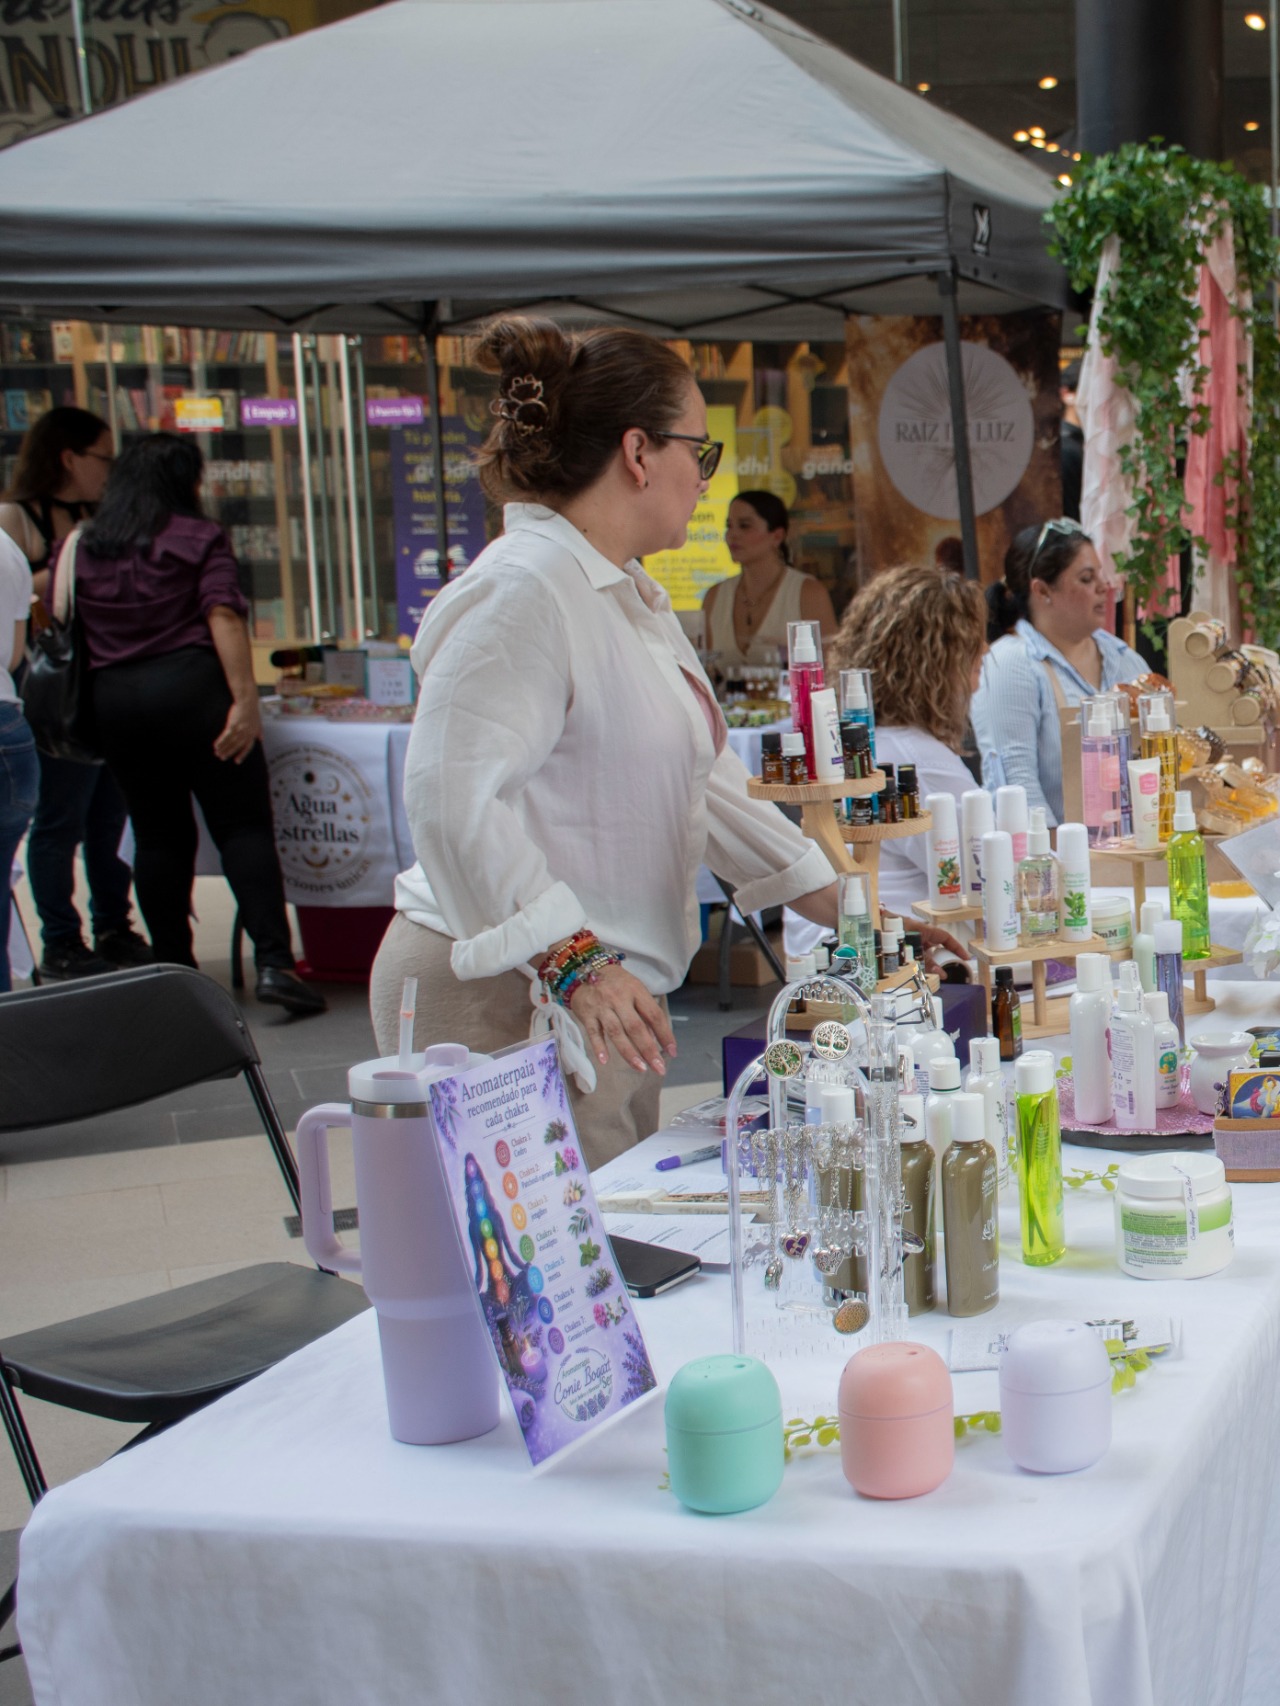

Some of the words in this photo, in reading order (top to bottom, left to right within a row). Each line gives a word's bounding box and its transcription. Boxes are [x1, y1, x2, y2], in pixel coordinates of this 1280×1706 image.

[0, 33, 192, 118] NDHI
[976, 422, 1015, 442] LUZ
[290, 793, 337, 817] Agua
[278, 822, 359, 842] strellas
[461, 1059, 536, 1101] Aromaterpaia
[467, 1088, 520, 1117] recomendado
[520, 1081, 538, 1101] para
[485, 1111, 504, 1129] cada
[503, 1101, 530, 1119] chakra
[554, 1379, 583, 1405] Conie
